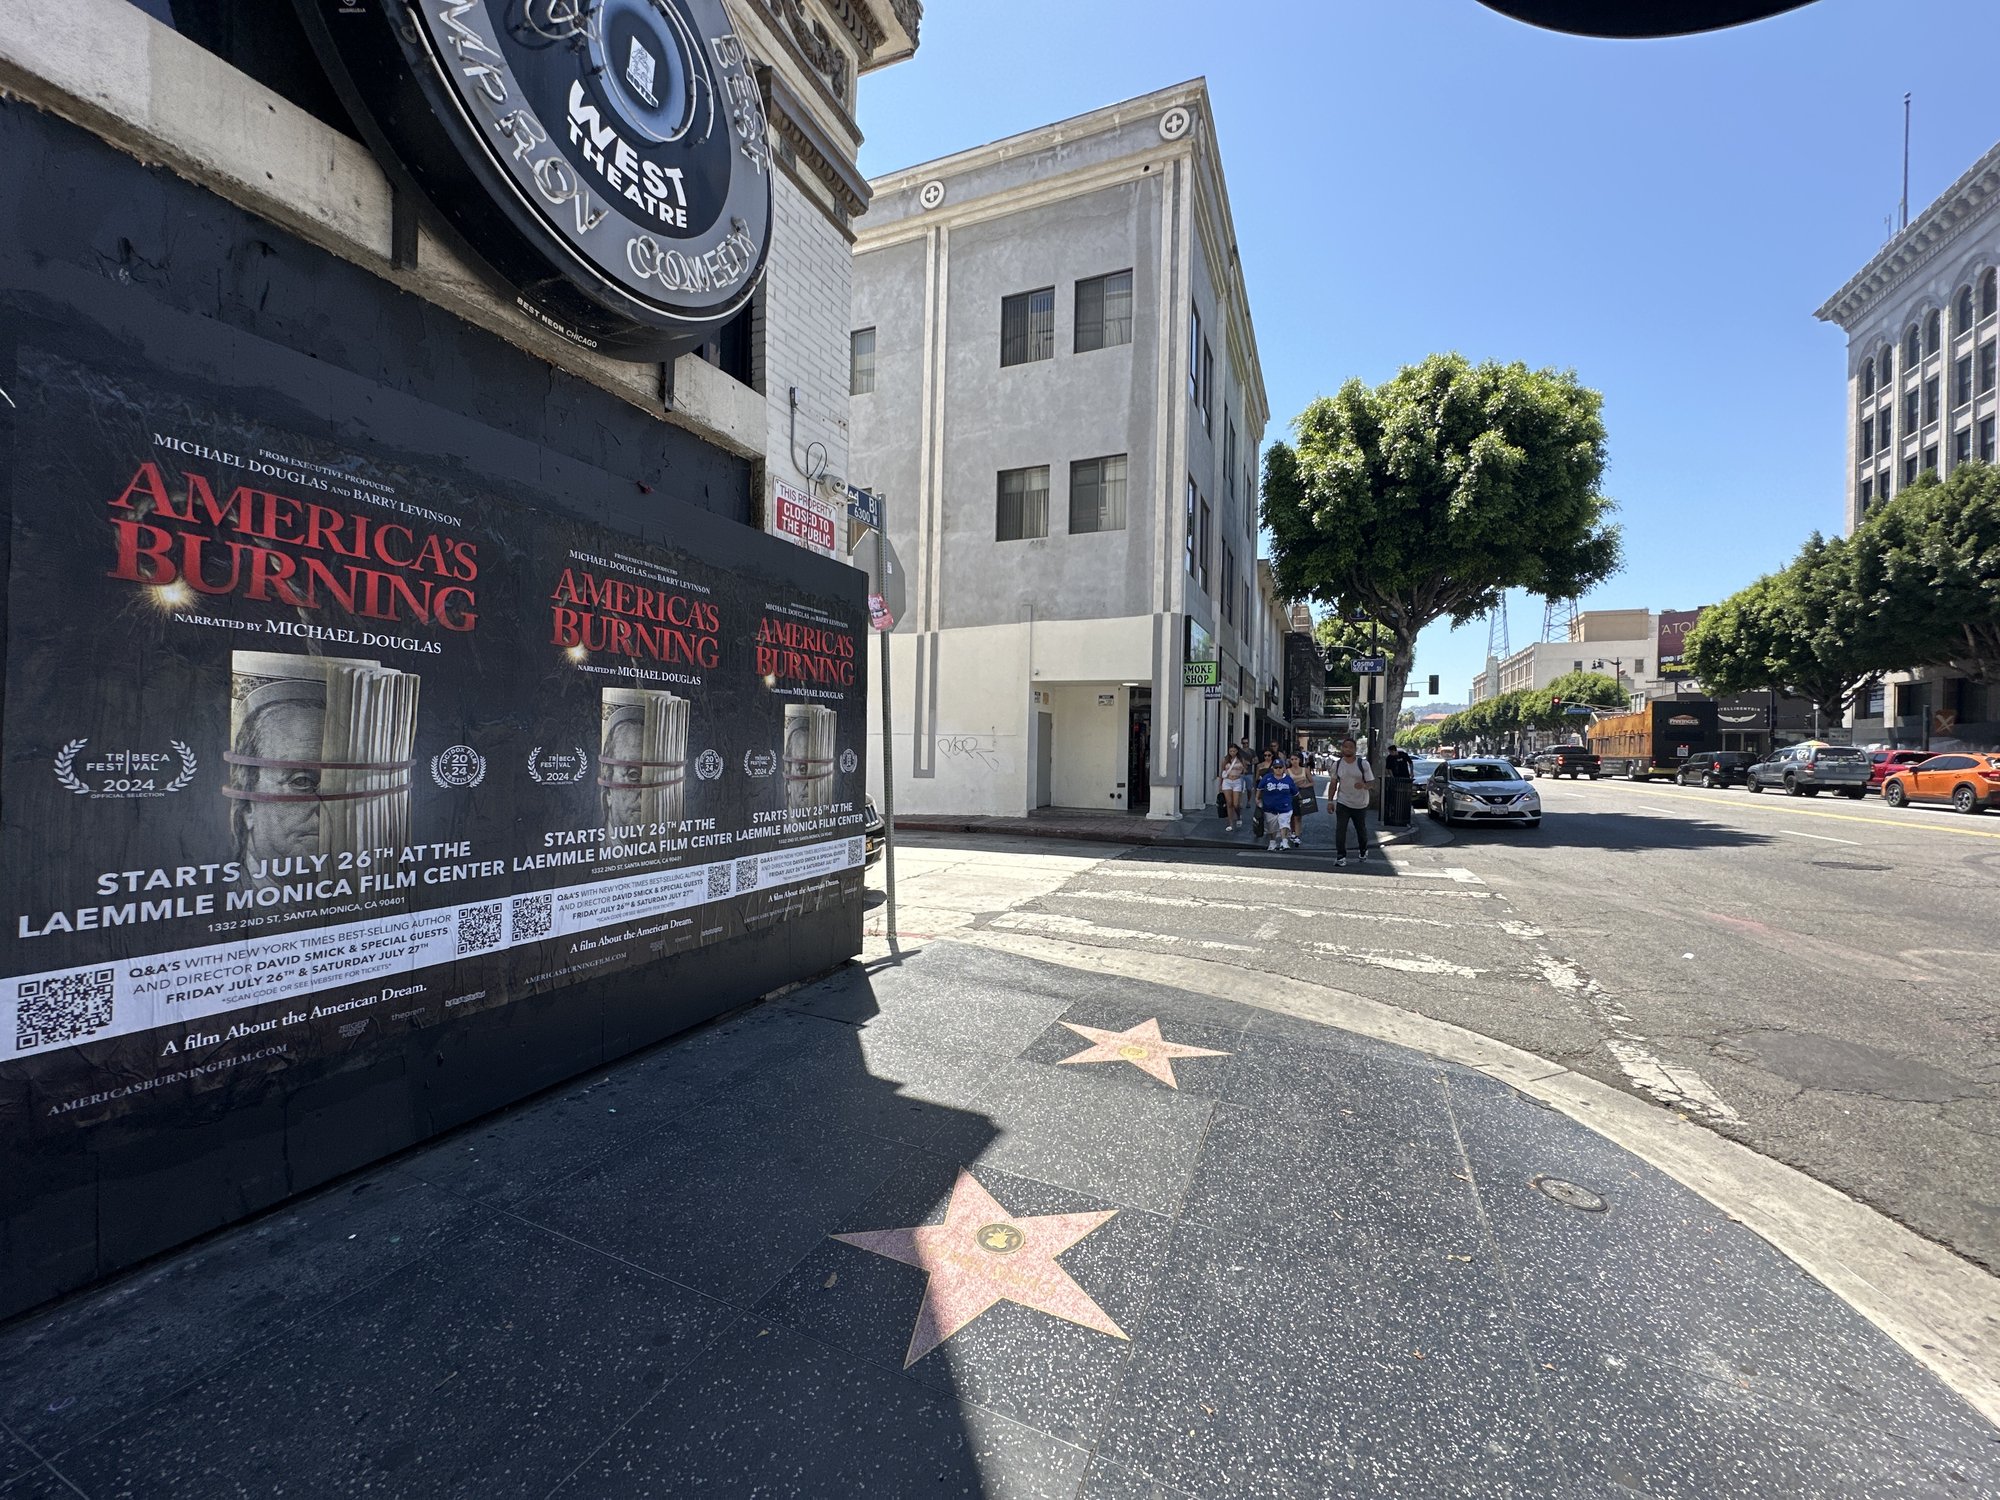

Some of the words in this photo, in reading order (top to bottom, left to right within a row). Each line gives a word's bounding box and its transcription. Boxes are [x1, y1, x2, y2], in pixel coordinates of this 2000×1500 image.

[438, 0, 608, 234] MPROV
[568, 79, 687, 206] WEST
[567, 115, 687, 229] THEATRE
[627, 217, 757, 293] COMEDY
[516, 297, 540, 319] BEST
[541, 314, 565, 334] NEON
[566, 329, 598, 349] CHICAGO
[153, 432, 244, 468] MICHAEL
[249, 458, 328, 491] DOUGLAS
[330, 486, 351, 497] AND
[353, 488, 398, 510] BARRY
[400, 502, 462, 528] LEVINSON
[258, 448, 289, 464] FROM
[290, 457, 344, 479] EXECUTIVE
[344, 473, 395, 494] PRODUCERS
[780, 485, 797, 503] THIS
[798, 493, 833, 518] PROPERTY
[783, 502, 818, 527] CLOSED
[818, 516, 829, 533] TO
[854, 506, 871, 523] 6300
[872, 514, 878, 526] W
[781, 515, 800, 535] THE
[801, 525, 831, 548] PUBLIC
[107, 517, 477, 633] BURNING
[569, 549, 609, 568] MICHAEL
[609, 560, 647, 578] DOUGLAS
[657, 573, 679, 586] BARRY
[679, 580, 711, 595] LEVINSON
[174, 613, 244, 631] NARRATED
[246, 621, 262, 633] BY
[265, 619, 359, 645] MICHAEL
[362, 632, 442, 654] DOUGLAS
[550, 605, 720, 669] BURNING
[577, 664, 610, 675] NARRATED
[617, 666, 661, 681] MICHAEL
[662, 671, 701, 686] DOUGLAS
[755, 645, 855, 687] BURNING
[1184, 664, 1213, 674] SMOKE
[1185, 674, 1209, 684] SHOP
[792, 687, 819, 698] MICHAEL
[819, 690, 844, 700] DOUGLAS
[1205, 685, 1222, 693] ATM
[86, 762, 159, 771] FESTIVAL
[105, 753, 170, 762] TRIBECA
[451, 754, 468, 763] 20
[451, 766, 467, 776] 24
[466, 750, 477, 764] FILM
[705, 755, 714, 763] 20
[102, 779, 155, 792] 2024
[444, 771, 474, 782] FESTIVAL
[546, 772, 570, 781] 2024
[736, 825, 781, 841] LAEMMLE
[783, 820, 818, 834] MONICA
[819, 817, 836, 829] FILM
[837, 813, 864, 826] CENTER
[752, 809, 788, 824] STARTS
[790, 807, 811, 821] JULY
[830, 803, 840, 813] AT
[840, 802, 853, 812] THE
[544, 827, 606, 847] STARTS
[610, 824, 645, 841] JULY
[678, 820, 693, 833] AT
[695, 817, 716, 831] THE
[96, 862, 241, 896] STARTS
[252, 854, 330, 879] JULY
[398, 844, 427, 864] AT
[430, 841, 471, 860] THE
[513, 849, 595, 872] LAEMMLE
[599, 840, 657, 861] MONICA
[659, 837, 688, 853] FILM
[691, 832, 733, 849] CENTER
[18, 894, 214, 938] LAEMMLE
[226, 878, 352, 911] MONICA
[360, 870, 417, 894] FILM
[423, 860, 505, 885] CENTER
[207, 920, 237, 933] 1332
[239, 917, 264, 928] 2ND
[266, 914, 281, 924] ST,
[283, 909, 318, 922] SANTA
[320, 903, 363, 916] MONICA,
[364, 901, 378, 910] CA
[379, 897, 406, 907] 90401
[184, 953, 223, 969] WITH
[227, 947, 260, 961] NEW
[262, 940, 298, 954] YORK
[300, 934, 336, 949] TIMES
[338, 921, 409, 942] BEST-SELLING
[411, 914, 452, 928] AUTHOR
[569, 943, 578, 954] A
[579, 939, 597, 951] film
[598, 934, 623, 947] About
[623, 929, 636, 940] the
[636, 923, 669, 938] American
[669, 917, 694, 928] Dream.
[133, 979, 171, 995] AND
[176, 964, 253, 987] DIRECTOR
[256, 955, 301, 971] DAVID
[304, 946, 346, 962] SMICK
[349, 944, 358, 953] &
[361, 935, 407, 951] SPECIAL
[409, 926, 449, 941] GUESTS
[166, 984, 225, 1005] FRIDAY
[228, 977, 263, 992] JULY
[298, 967, 308, 977] &
[311, 954, 376, 975] SATURDAY
[378, 948, 406, 961] JULY
[252, 987, 278, 998] CODE
[293, 981, 309, 990] SEE
[309, 974, 343, 986] WEBSITE
[344, 970, 360, 978] FOR
[161, 1040, 179, 1057] A
[184, 1034, 221, 1052] film
[224, 1019, 278, 1042] About
[282, 1012, 308, 1027] the
[309, 995, 377, 1020] American
[380, 983, 427, 1001] Dream.
[47, 1043, 288, 1116] AMERICASBURNINGFILM.COM
